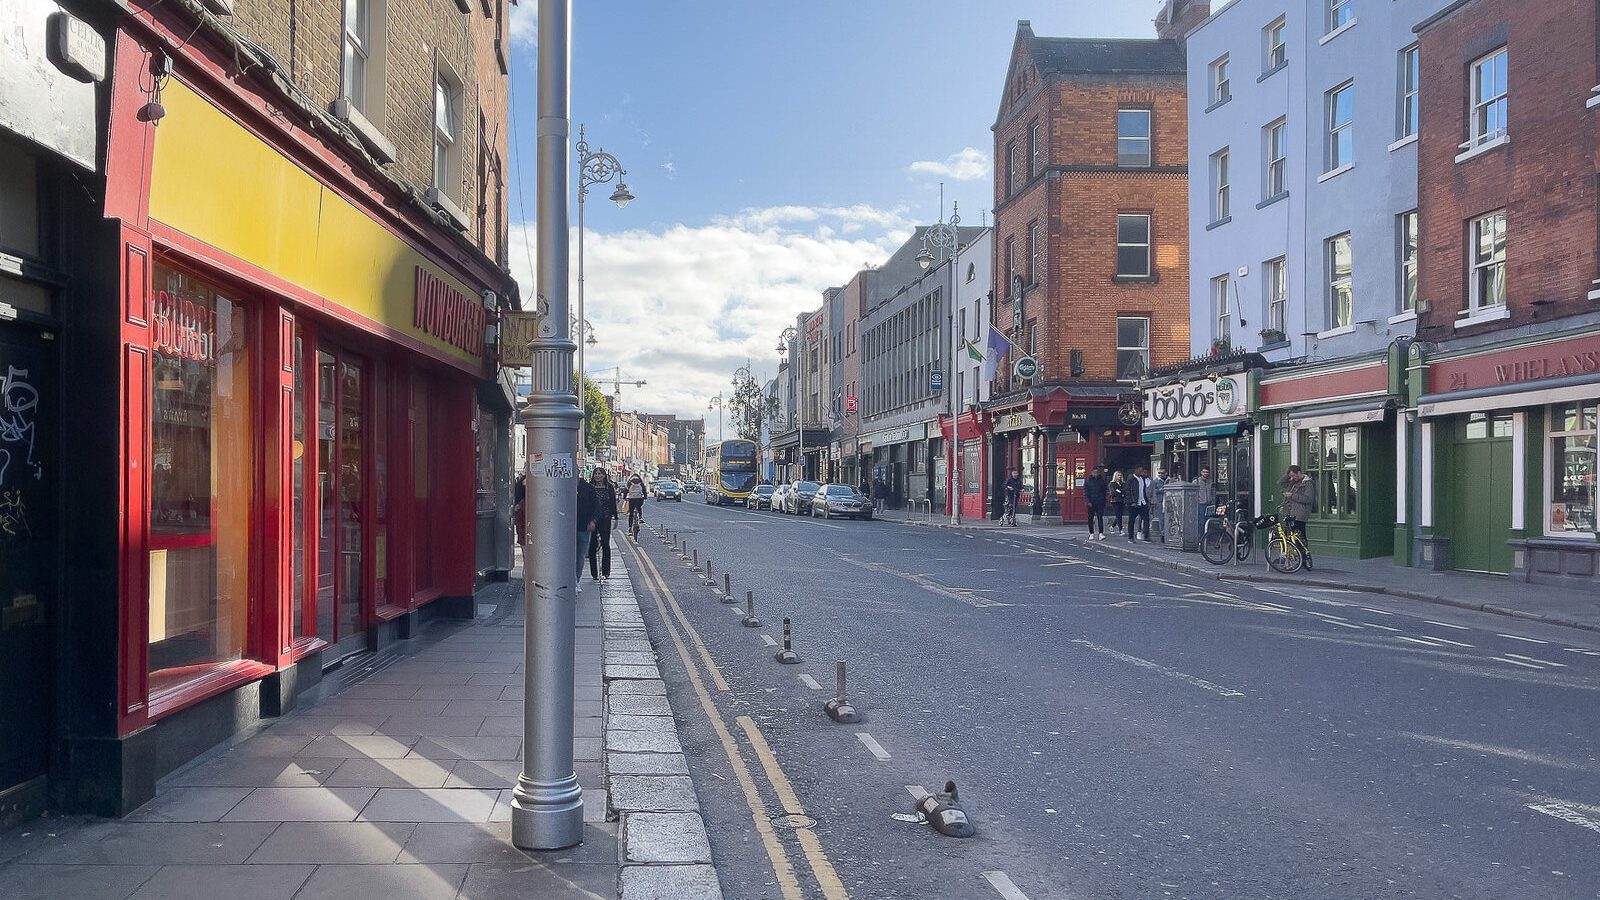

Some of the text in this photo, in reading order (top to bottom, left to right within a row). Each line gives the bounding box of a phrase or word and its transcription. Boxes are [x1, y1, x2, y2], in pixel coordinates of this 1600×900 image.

[70, 18, 104, 53] CELTIC
[414, 265, 487, 358] WOWBURGER
[553, 458, 567, 467] BIG
